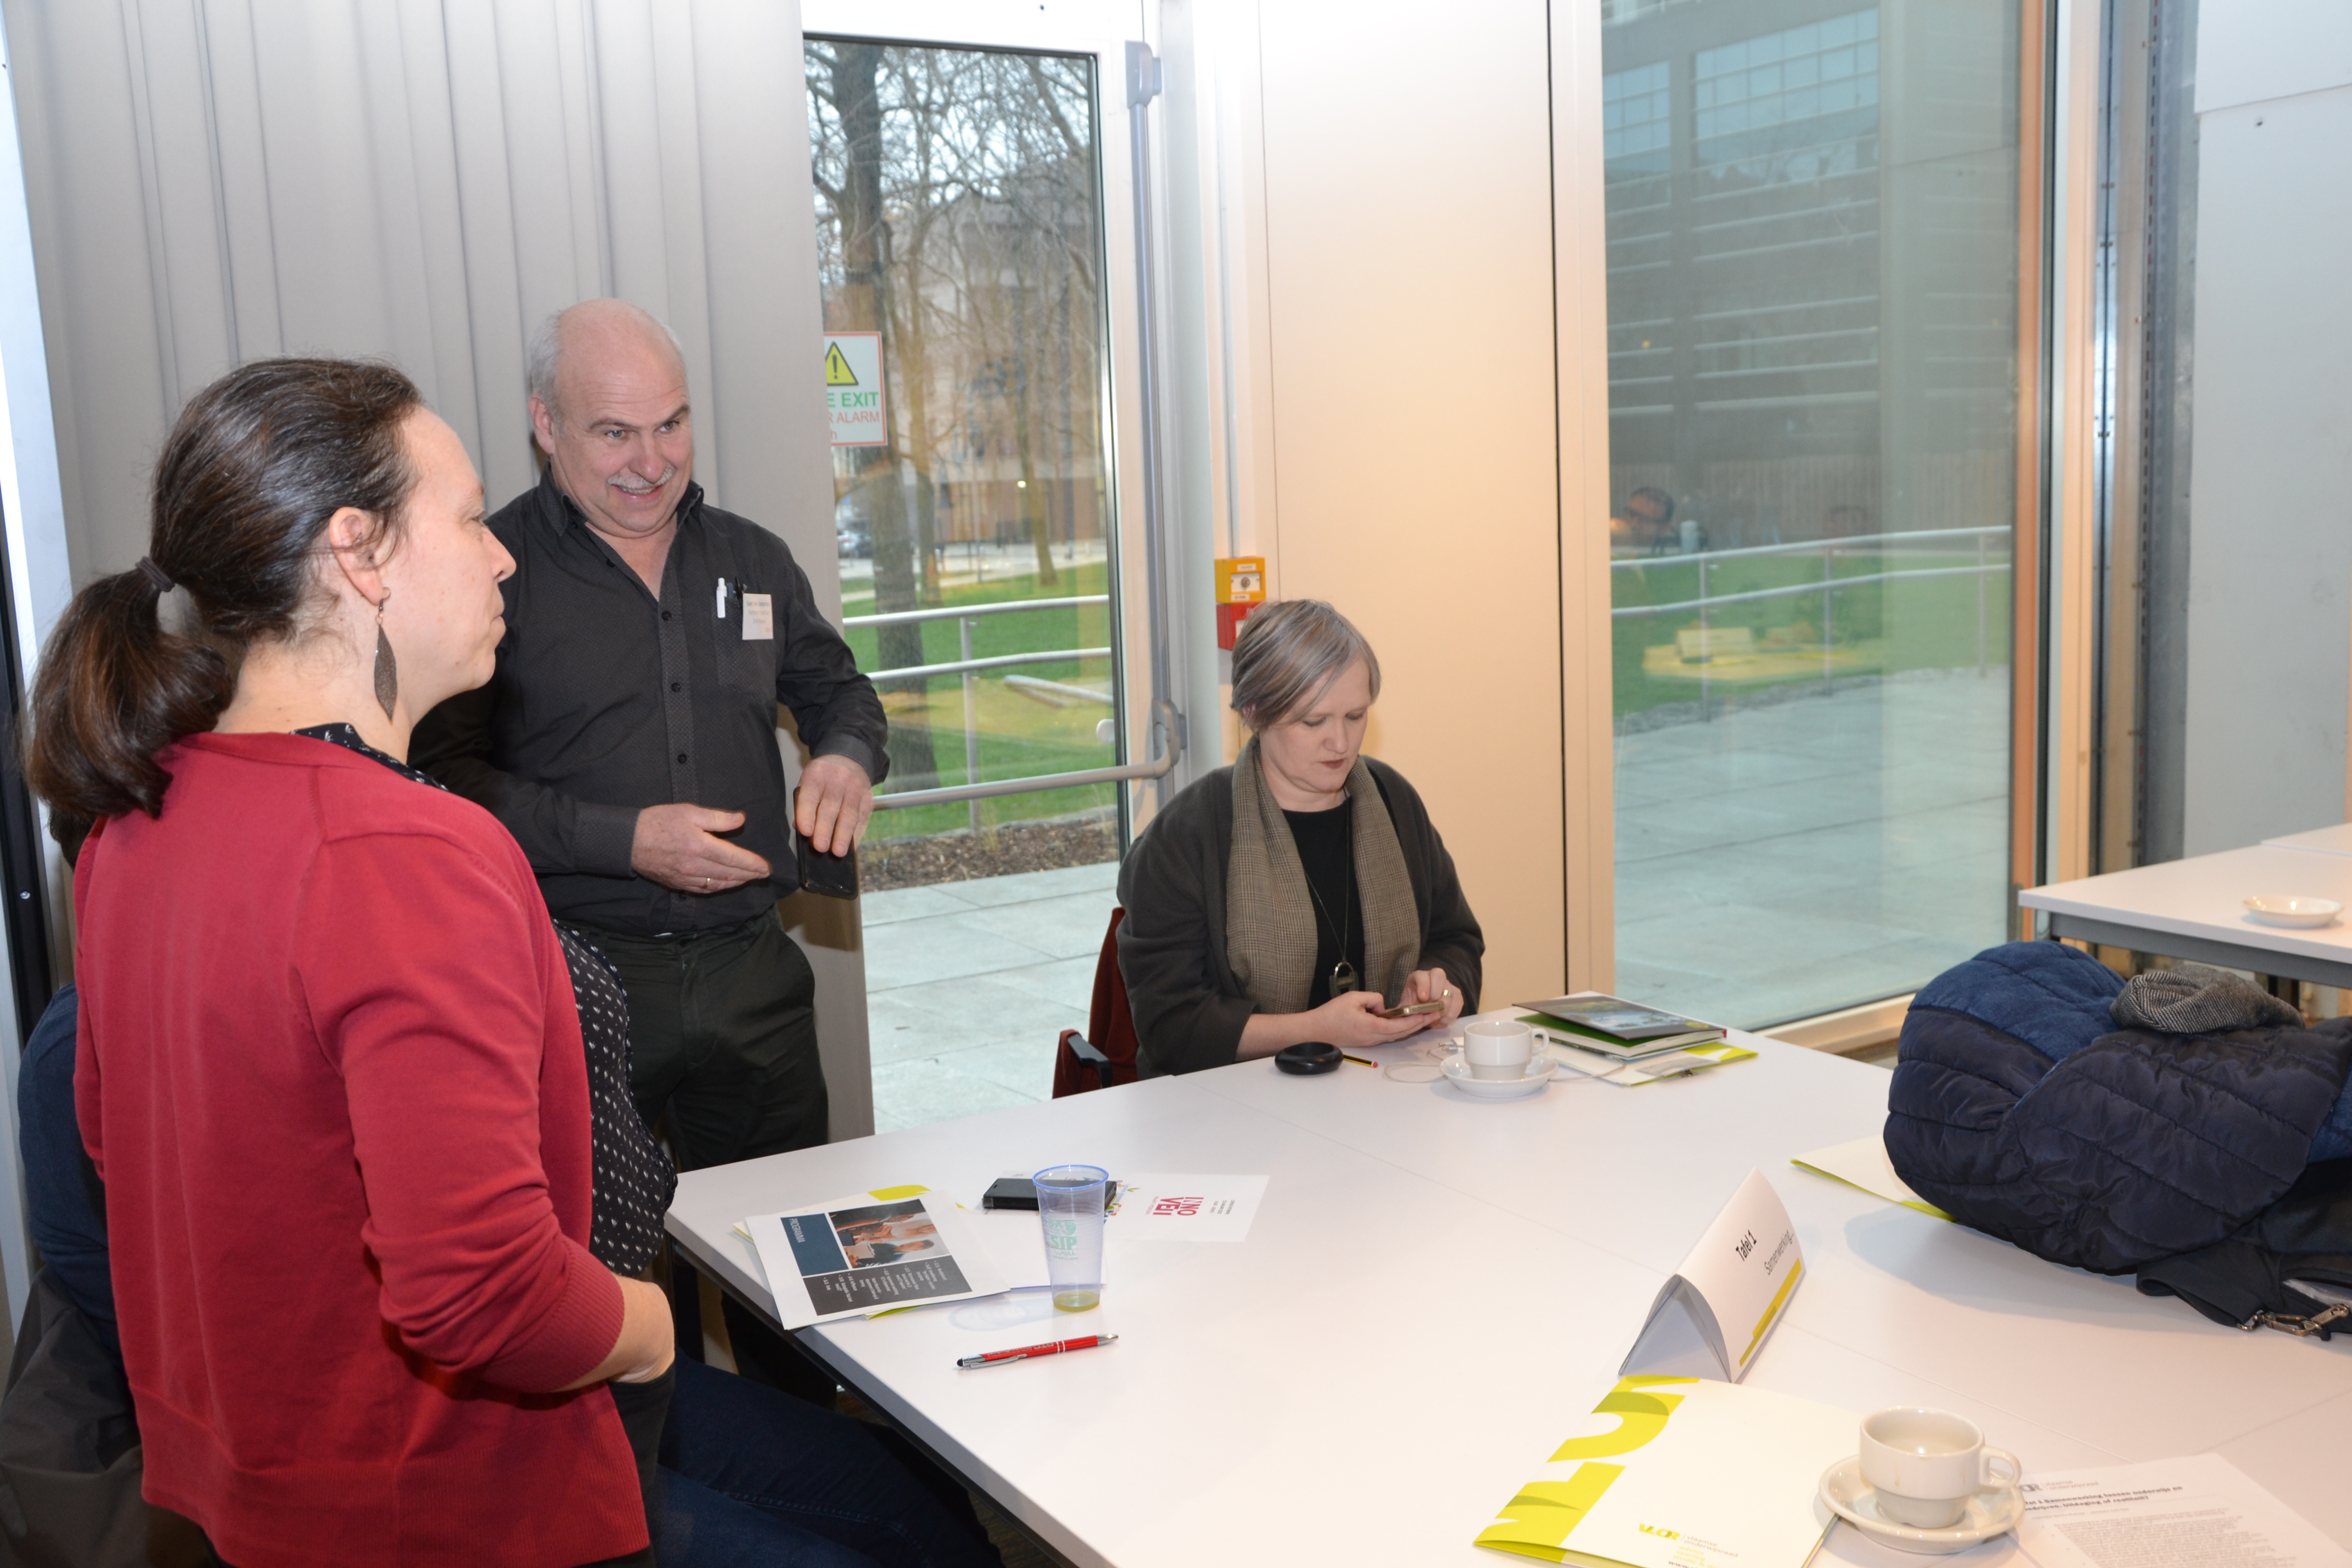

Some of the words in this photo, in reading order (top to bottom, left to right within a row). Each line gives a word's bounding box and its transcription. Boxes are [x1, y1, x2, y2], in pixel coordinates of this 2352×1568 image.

[842, 391, 878, 407] EXIT
[837, 411, 879, 423] ALARM
[789, 1218, 806, 1243] PROGRAMMA
[1050, 1235, 1077, 1250] SIP
[1735, 1234, 1753, 1262] Tafel
[1748, 1229, 1757, 1245] 1
[1638, 1523, 1680, 1541] VLOR
[1684, 1539, 1738, 1558] onderwijsraad
[1687, 1535, 1718, 1547] vlaamse
[1679, 1546, 1704, 1555] advies
